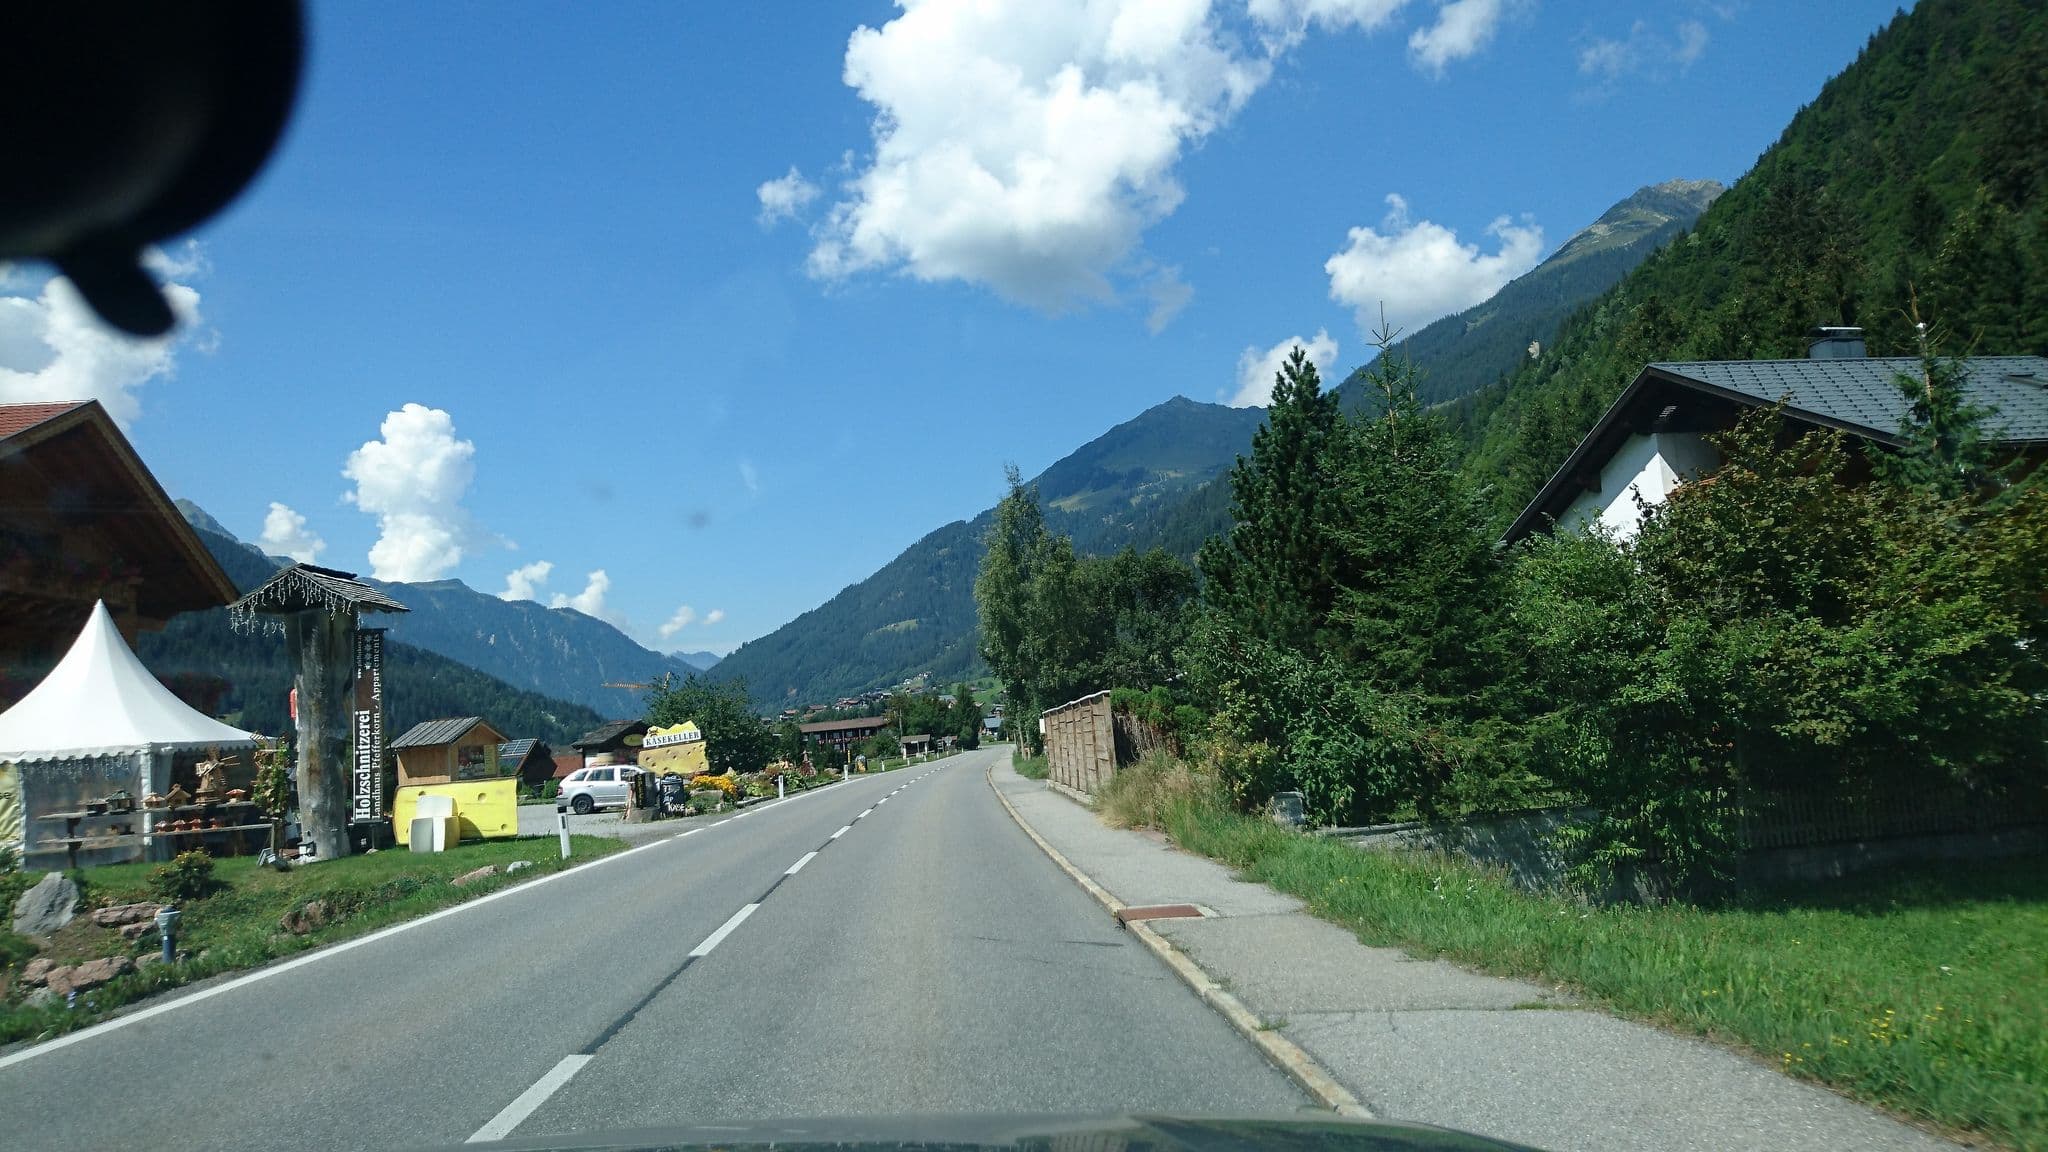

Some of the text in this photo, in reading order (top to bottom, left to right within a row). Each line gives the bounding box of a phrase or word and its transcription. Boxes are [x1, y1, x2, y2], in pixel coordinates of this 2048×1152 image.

[371, 633, 381, 701] Appartements
[355, 709, 371, 820] Holzschnitzerei
[371, 712, 381, 769] Pfefferkorn
[371, 772, 381, 820] Landhaus
